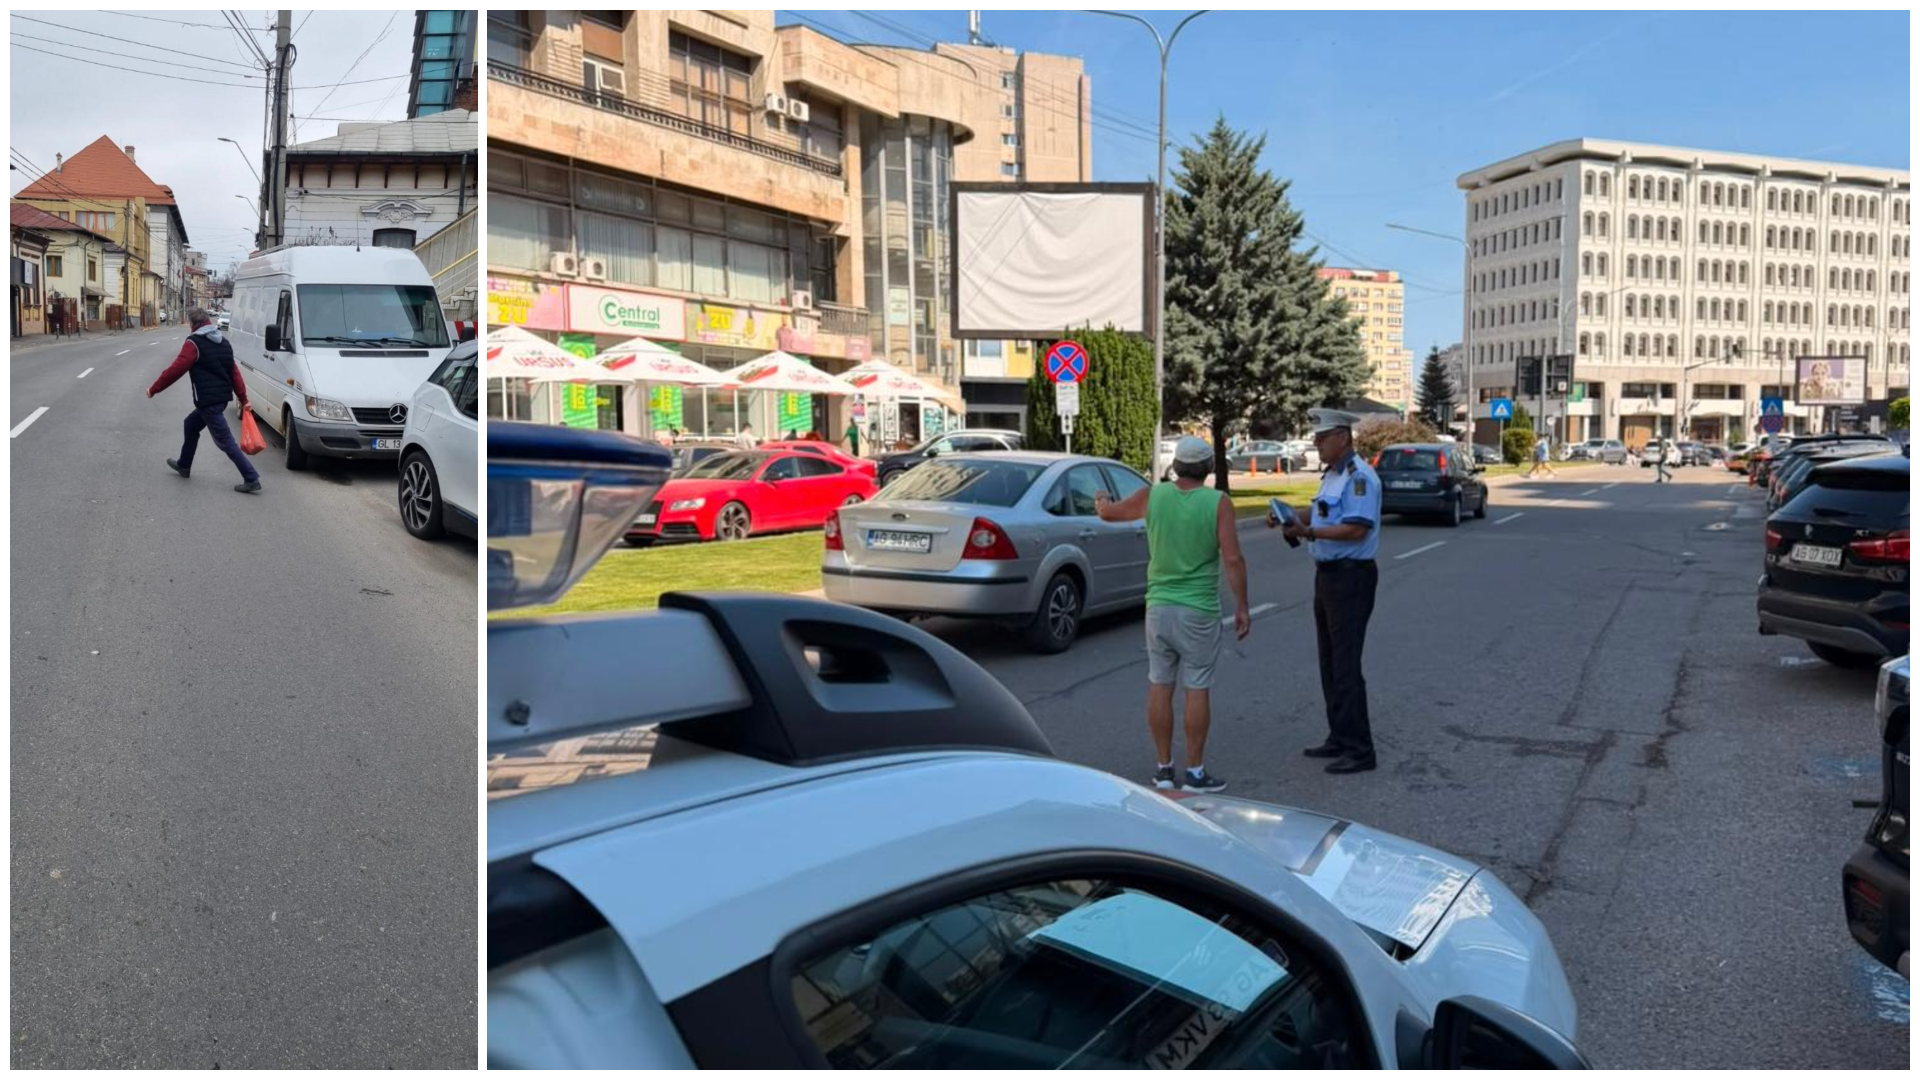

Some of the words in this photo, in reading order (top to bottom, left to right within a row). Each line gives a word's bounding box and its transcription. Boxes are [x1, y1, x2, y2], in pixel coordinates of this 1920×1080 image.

[498, 304, 527, 324] ZU
[604, 302, 660, 322] Central
[378, 439, 389, 449] GL
[1794, 546, 1807, 559] AG
